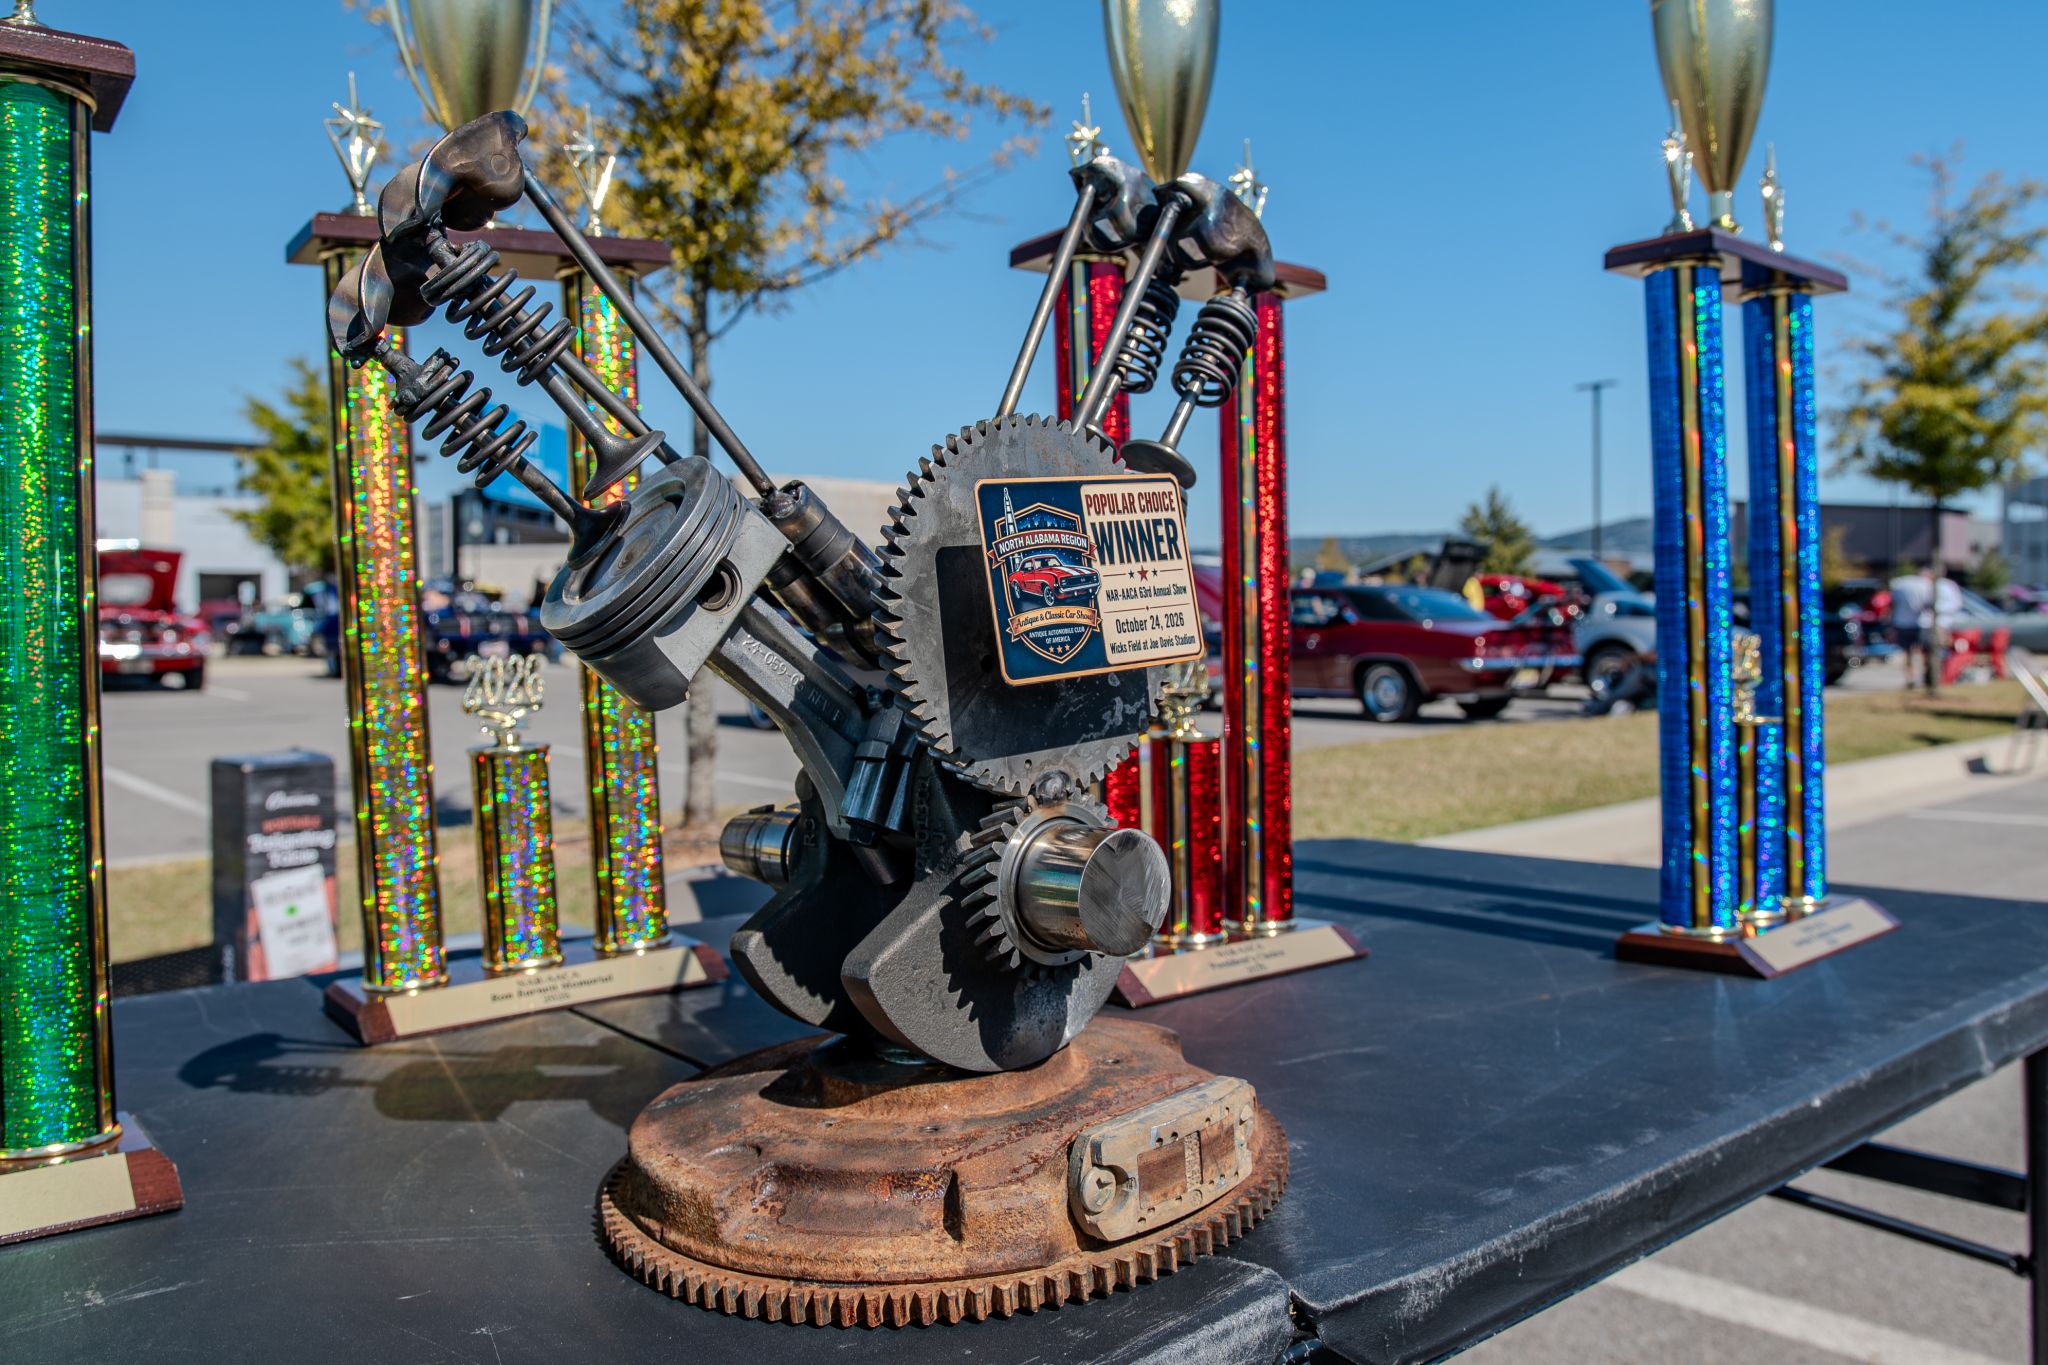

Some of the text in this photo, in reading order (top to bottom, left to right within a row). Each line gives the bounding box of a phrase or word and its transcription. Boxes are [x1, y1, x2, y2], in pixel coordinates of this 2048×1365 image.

[1085, 491, 1176, 516] POPULAR CHOICE
[998, 533, 1088, 554] NORTH ALABAMA REGION
[1090, 518, 1182, 566] WINNER
[1105, 583, 1187, 602] NAR-AACA 63rd Annual Show
[1014, 615, 1039, 630] Antique
[1040, 613, 1045, 621] &
[1045, 610, 1065, 621] Classic
[1065, 609, 1076, 619] Car
[1115, 611, 1185, 634] October 24, 2026
[1045, 635, 1071, 645] OF AMERICA
[1110, 633, 1196, 655] Wicks Field at Joe Davis Stadium
[463, 654, 545, 706] 2026
